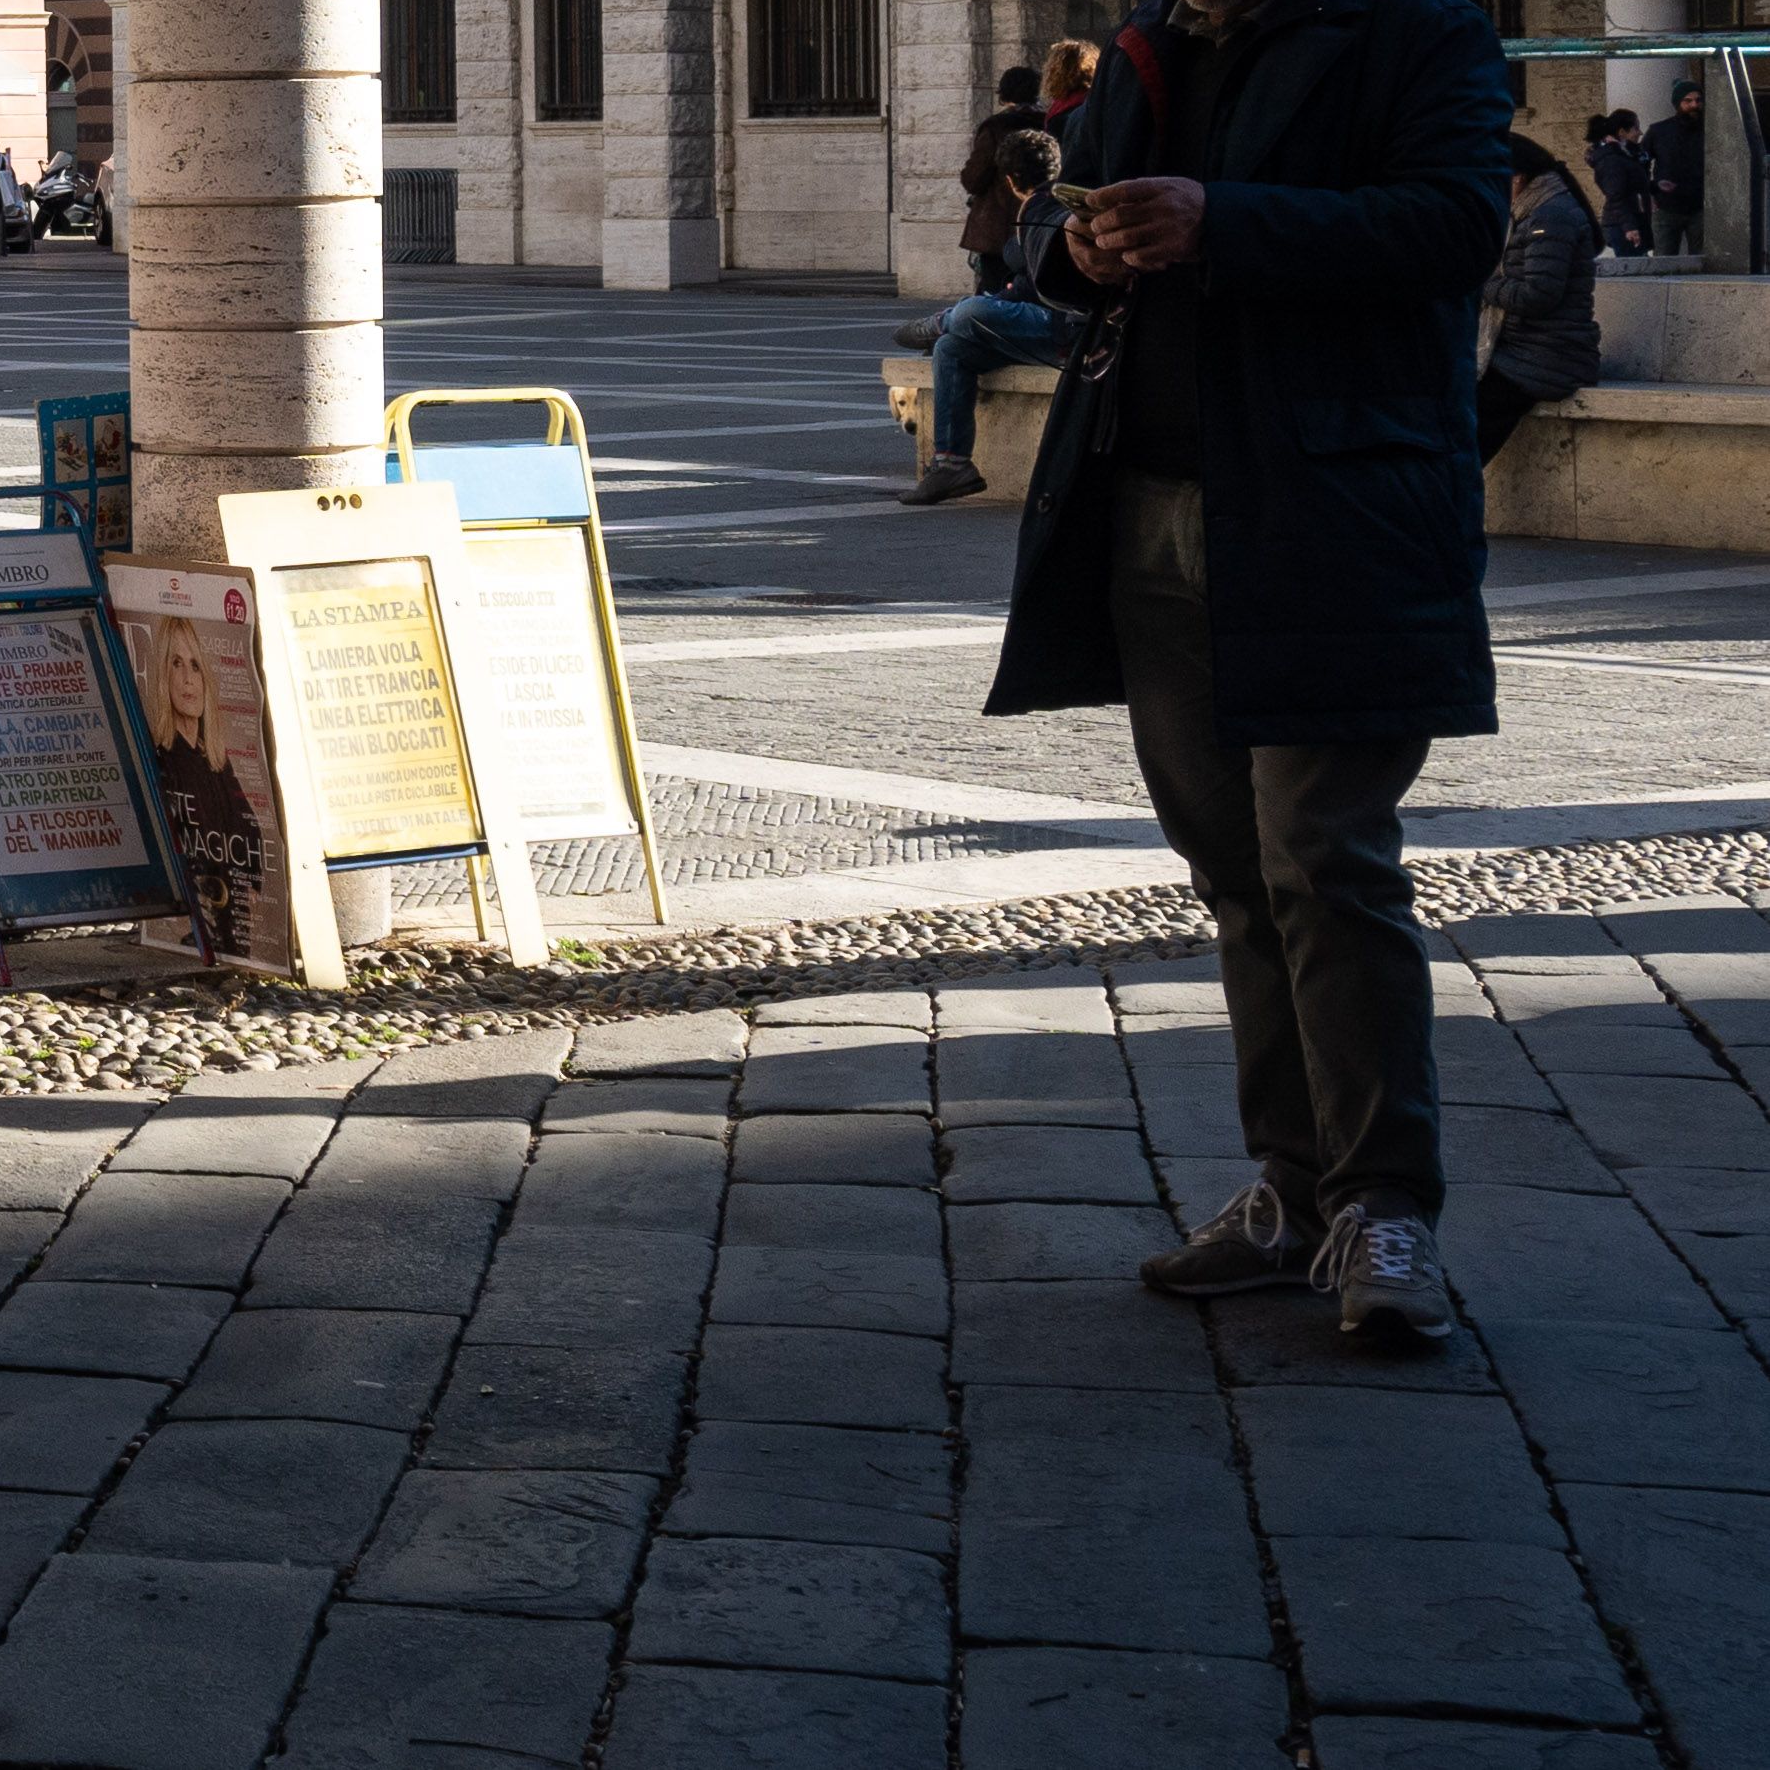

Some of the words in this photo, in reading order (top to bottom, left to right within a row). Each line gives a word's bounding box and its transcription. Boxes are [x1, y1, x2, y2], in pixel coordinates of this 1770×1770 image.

[291, 608, 322, 629] LA
[324, 599, 424, 626] STAMPA
[306, 643, 379, 672] LAMIERA
[378, 639, 424, 665] VOLA
[544, 653, 585, 675] LICEO
[24, 661, 86, 679] PRIAMAR
[14, 677, 90, 697] SORPRESE
[303, 678, 327, 702] DA
[326, 675, 354, 700] TIR
[355, 674, 367, 697] E
[366, 667, 441, 696] TRANCIA
[504, 680, 557, 702] LASCIA
[27, 695, 85, 709] CATTEDRALE
[24, 712, 106, 733] CAMBIATA
[309, 705, 356, 731] LINEA
[356, 696, 446, 727] ELETTRICA
[519, 709, 533, 729] IN
[534, 707, 587, 728] RUSSIA
[14, 733, 86, 752] VIABILITA'
[317, 734, 365, 760] TRENI
[366, 725, 449, 756] BLOCCATI
[14, 755, 31, 767] PER
[33, 753, 64, 766] RIFARE
[66, 753, 74, 764] IL
[76, 750, 107, 763] PONTE
[39, 770, 69, 787] DON
[71, 766, 120, 784] BOSCO
[366, 769, 404, 786] MANCA
[404, 767, 419, 782] UN
[420, 762, 459, 779] CODICE
[20, 785, 108, 806] RIPARTENZA
[328, 792, 359, 809] SALTA
[361, 791, 374, 806] LA
[374, 787, 404, 805] PISTA
[405, 781, 459, 801] CICLABILE
[4, 814, 26, 833] LA
[30, 808, 116, 830] FILOSOFIA
[415, 808, 471, 827] NATALE
[4, 834, 39, 854] DEL
